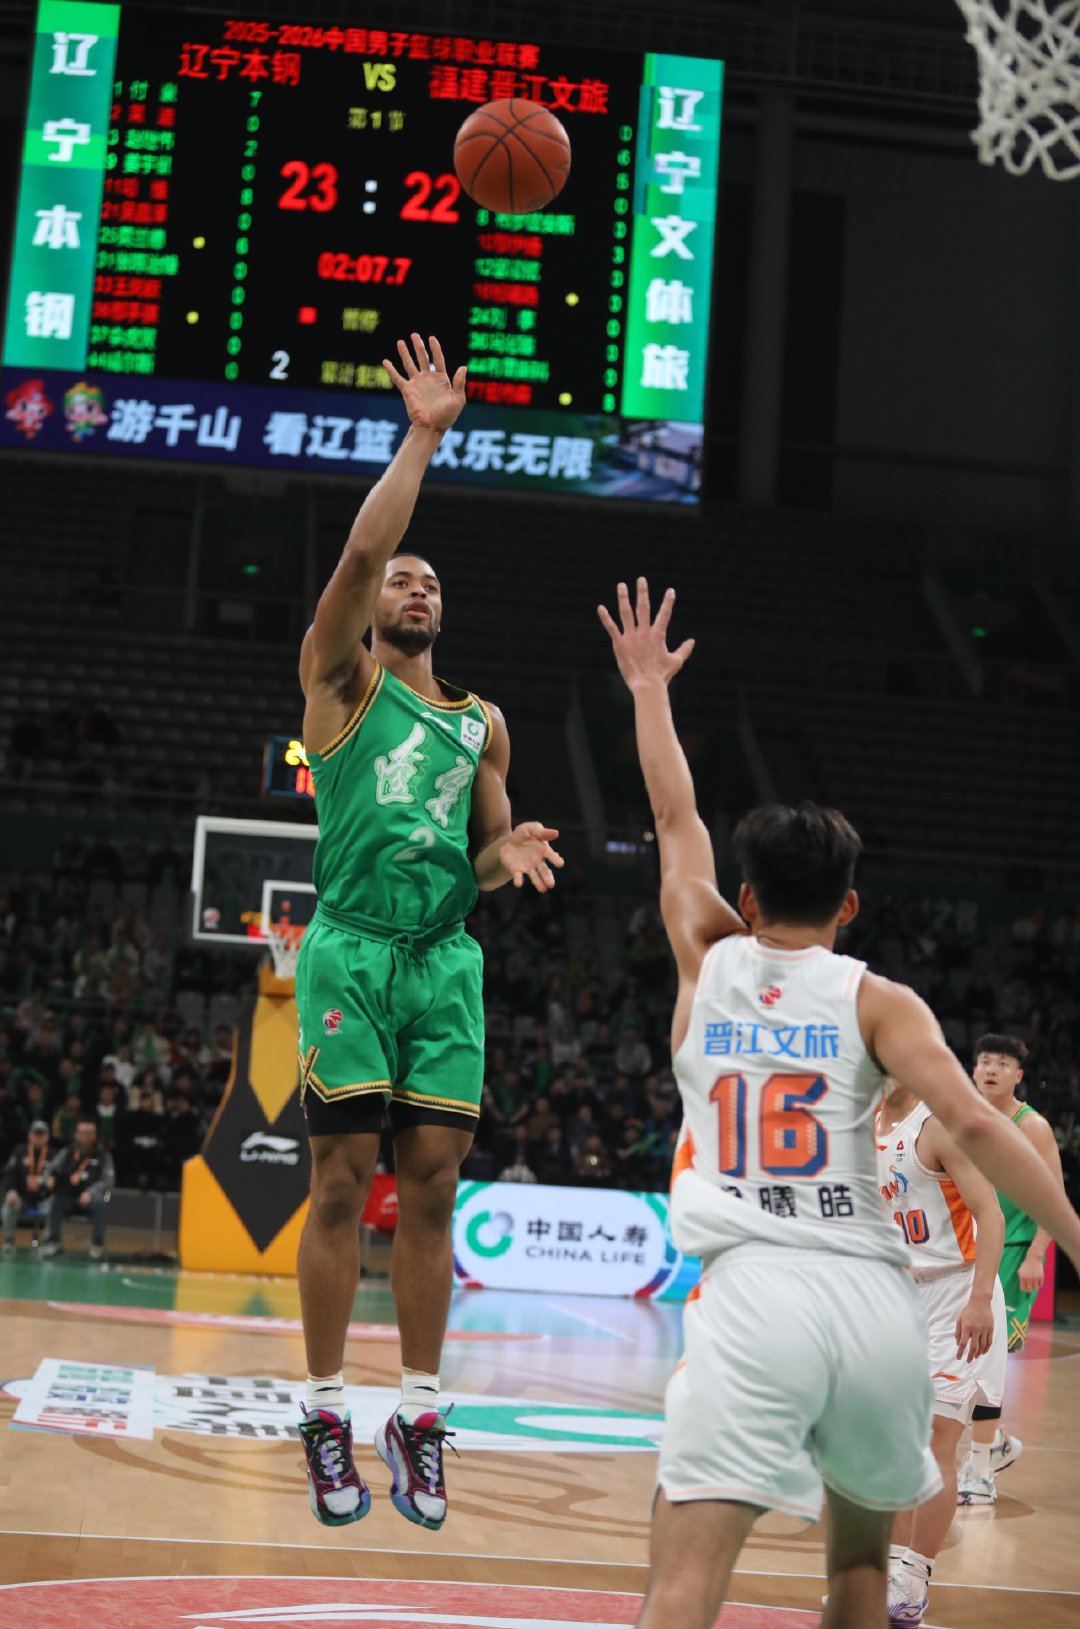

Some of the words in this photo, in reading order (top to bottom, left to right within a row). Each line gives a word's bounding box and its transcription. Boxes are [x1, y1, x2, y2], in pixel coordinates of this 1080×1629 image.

[178, 42, 301, 86] 辽宁本钢
[362, 62, 396, 92] VS
[249, 91, 262, 107] 7
[243, 140, 258, 157] 2
[27, 32, 98, 339] 辽宁本钢
[277, 160, 339, 213] 23
[400, 171, 461, 224] 22
[641, 86, 704, 391] 辽宁文体旅
[317, 252, 412, 285] 02:07.7
[270, 350, 290, 380] 2
[106, 399, 241, 451] 游千山
[263, 411, 398, 464] 看辽篮
[392, 825, 435, 861] 2
[704, 1020, 839, 1060] 晋江文旅
[709, 1072, 830, 1179] 16
[720, 1184, 854, 1218] 曦皓
[526, 1217, 649, 1248] 中国人寿
[894, 1209, 930, 1245] 10
[525, 1245, 593, 1263] CHINA
[600, 1250, 646, 1266] LIFE
